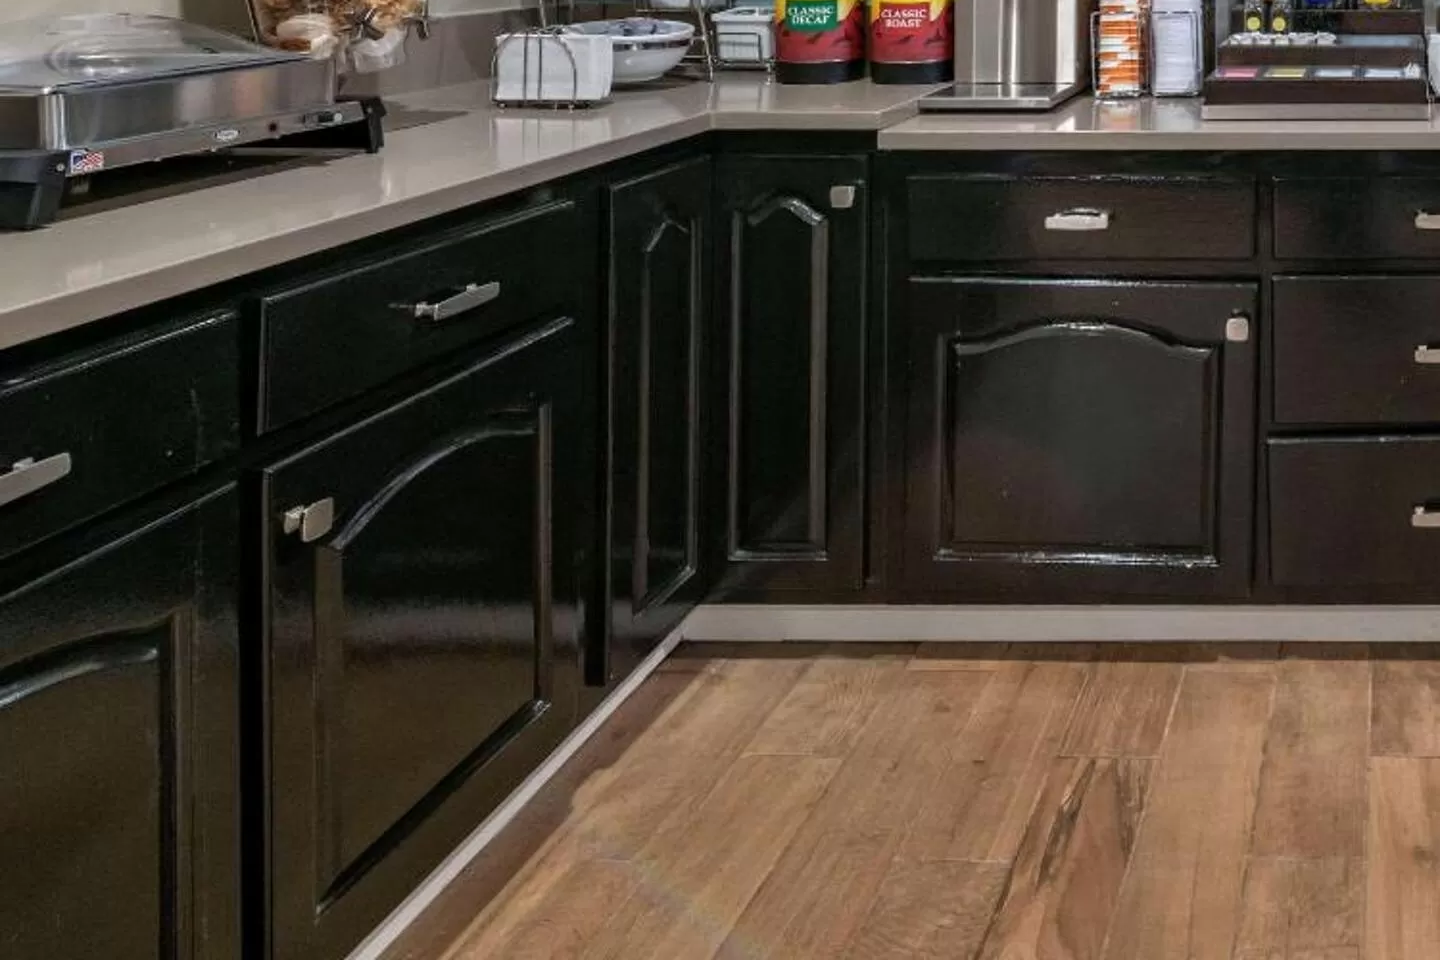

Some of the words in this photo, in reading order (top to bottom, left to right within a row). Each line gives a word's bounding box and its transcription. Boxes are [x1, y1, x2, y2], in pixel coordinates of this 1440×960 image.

[788, 5, 834, 17] CLASSIC
[881, 8, 927, 20] CLASSIC
[792, 14, 830, 26] DECAF
[885, 17, 922, 29] ROAST
